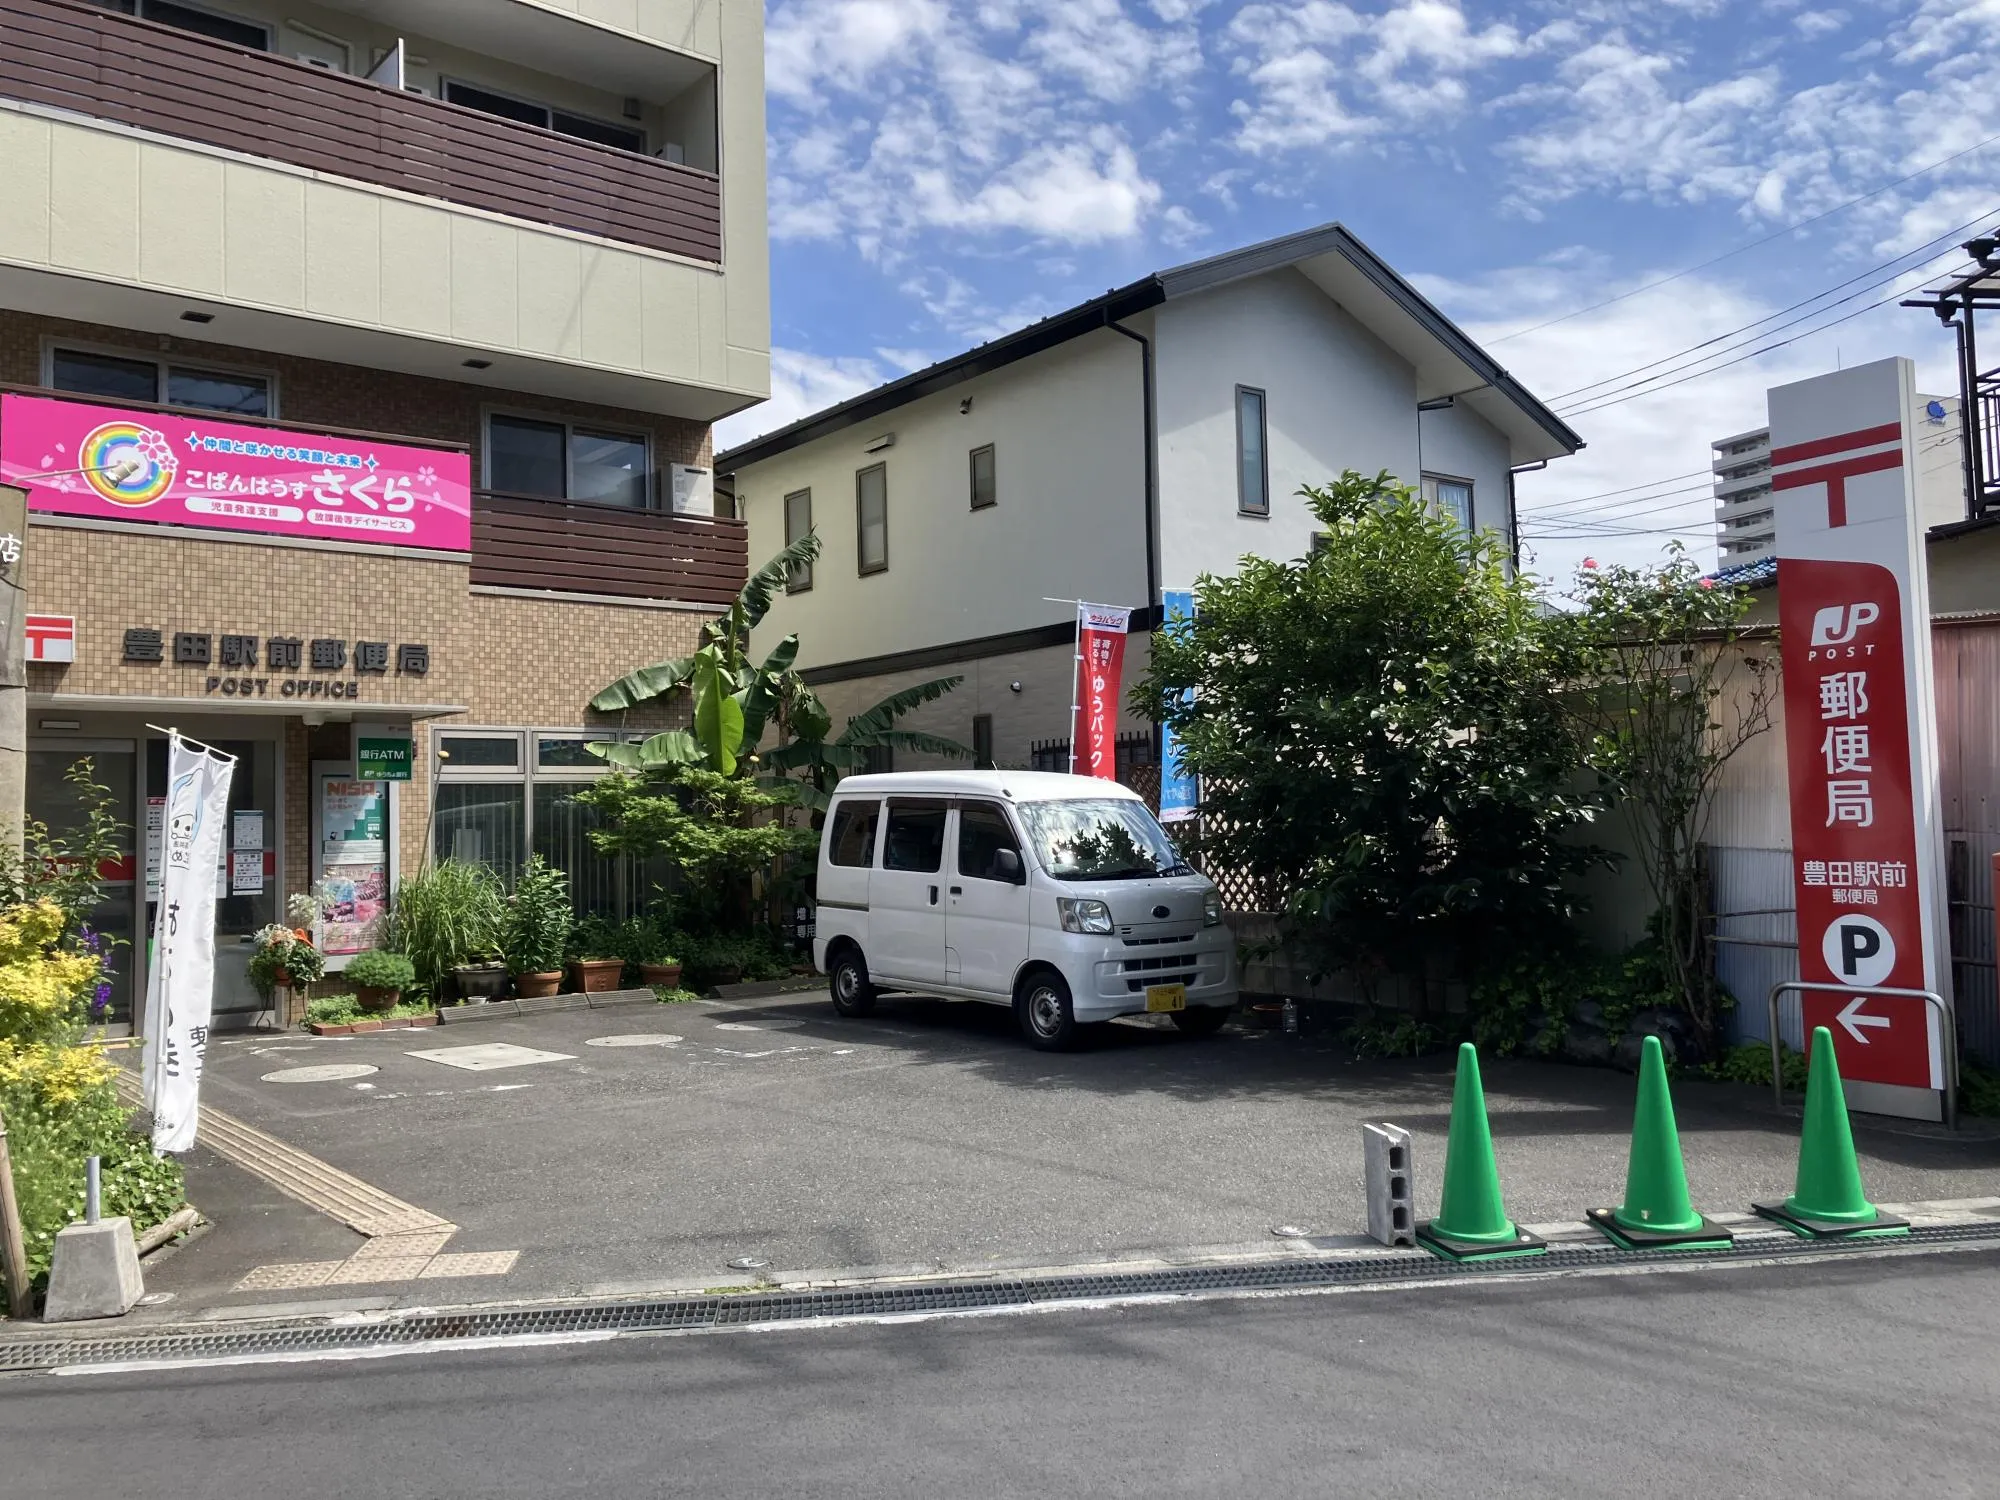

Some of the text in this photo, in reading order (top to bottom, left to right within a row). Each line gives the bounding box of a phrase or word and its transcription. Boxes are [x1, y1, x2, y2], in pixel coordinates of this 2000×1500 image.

[203, 437, 362, 468] 仲間と咲かせる笑顔と未来
[211, 501, 279, 517] 児童発達支援
[314, 512, 408, 529] 放課後等デイサービス
[124, 628, 429, 674] 豊田駅前郵便局
[1808, 644, 1875, 661] POST
[207, 676, 359, 698] POST OFFICE
[1090, 675, 1105, 768] ゆうパック
[360, 749, 405, 760] 銀行ATM
[1819, 671, 1874, 828] 郵便局
[1802, 860, 1907, 888] 豊田駅前
[1832, 888, 1878, 905] 郵便局
[1840, 924, 1881, 976] P
